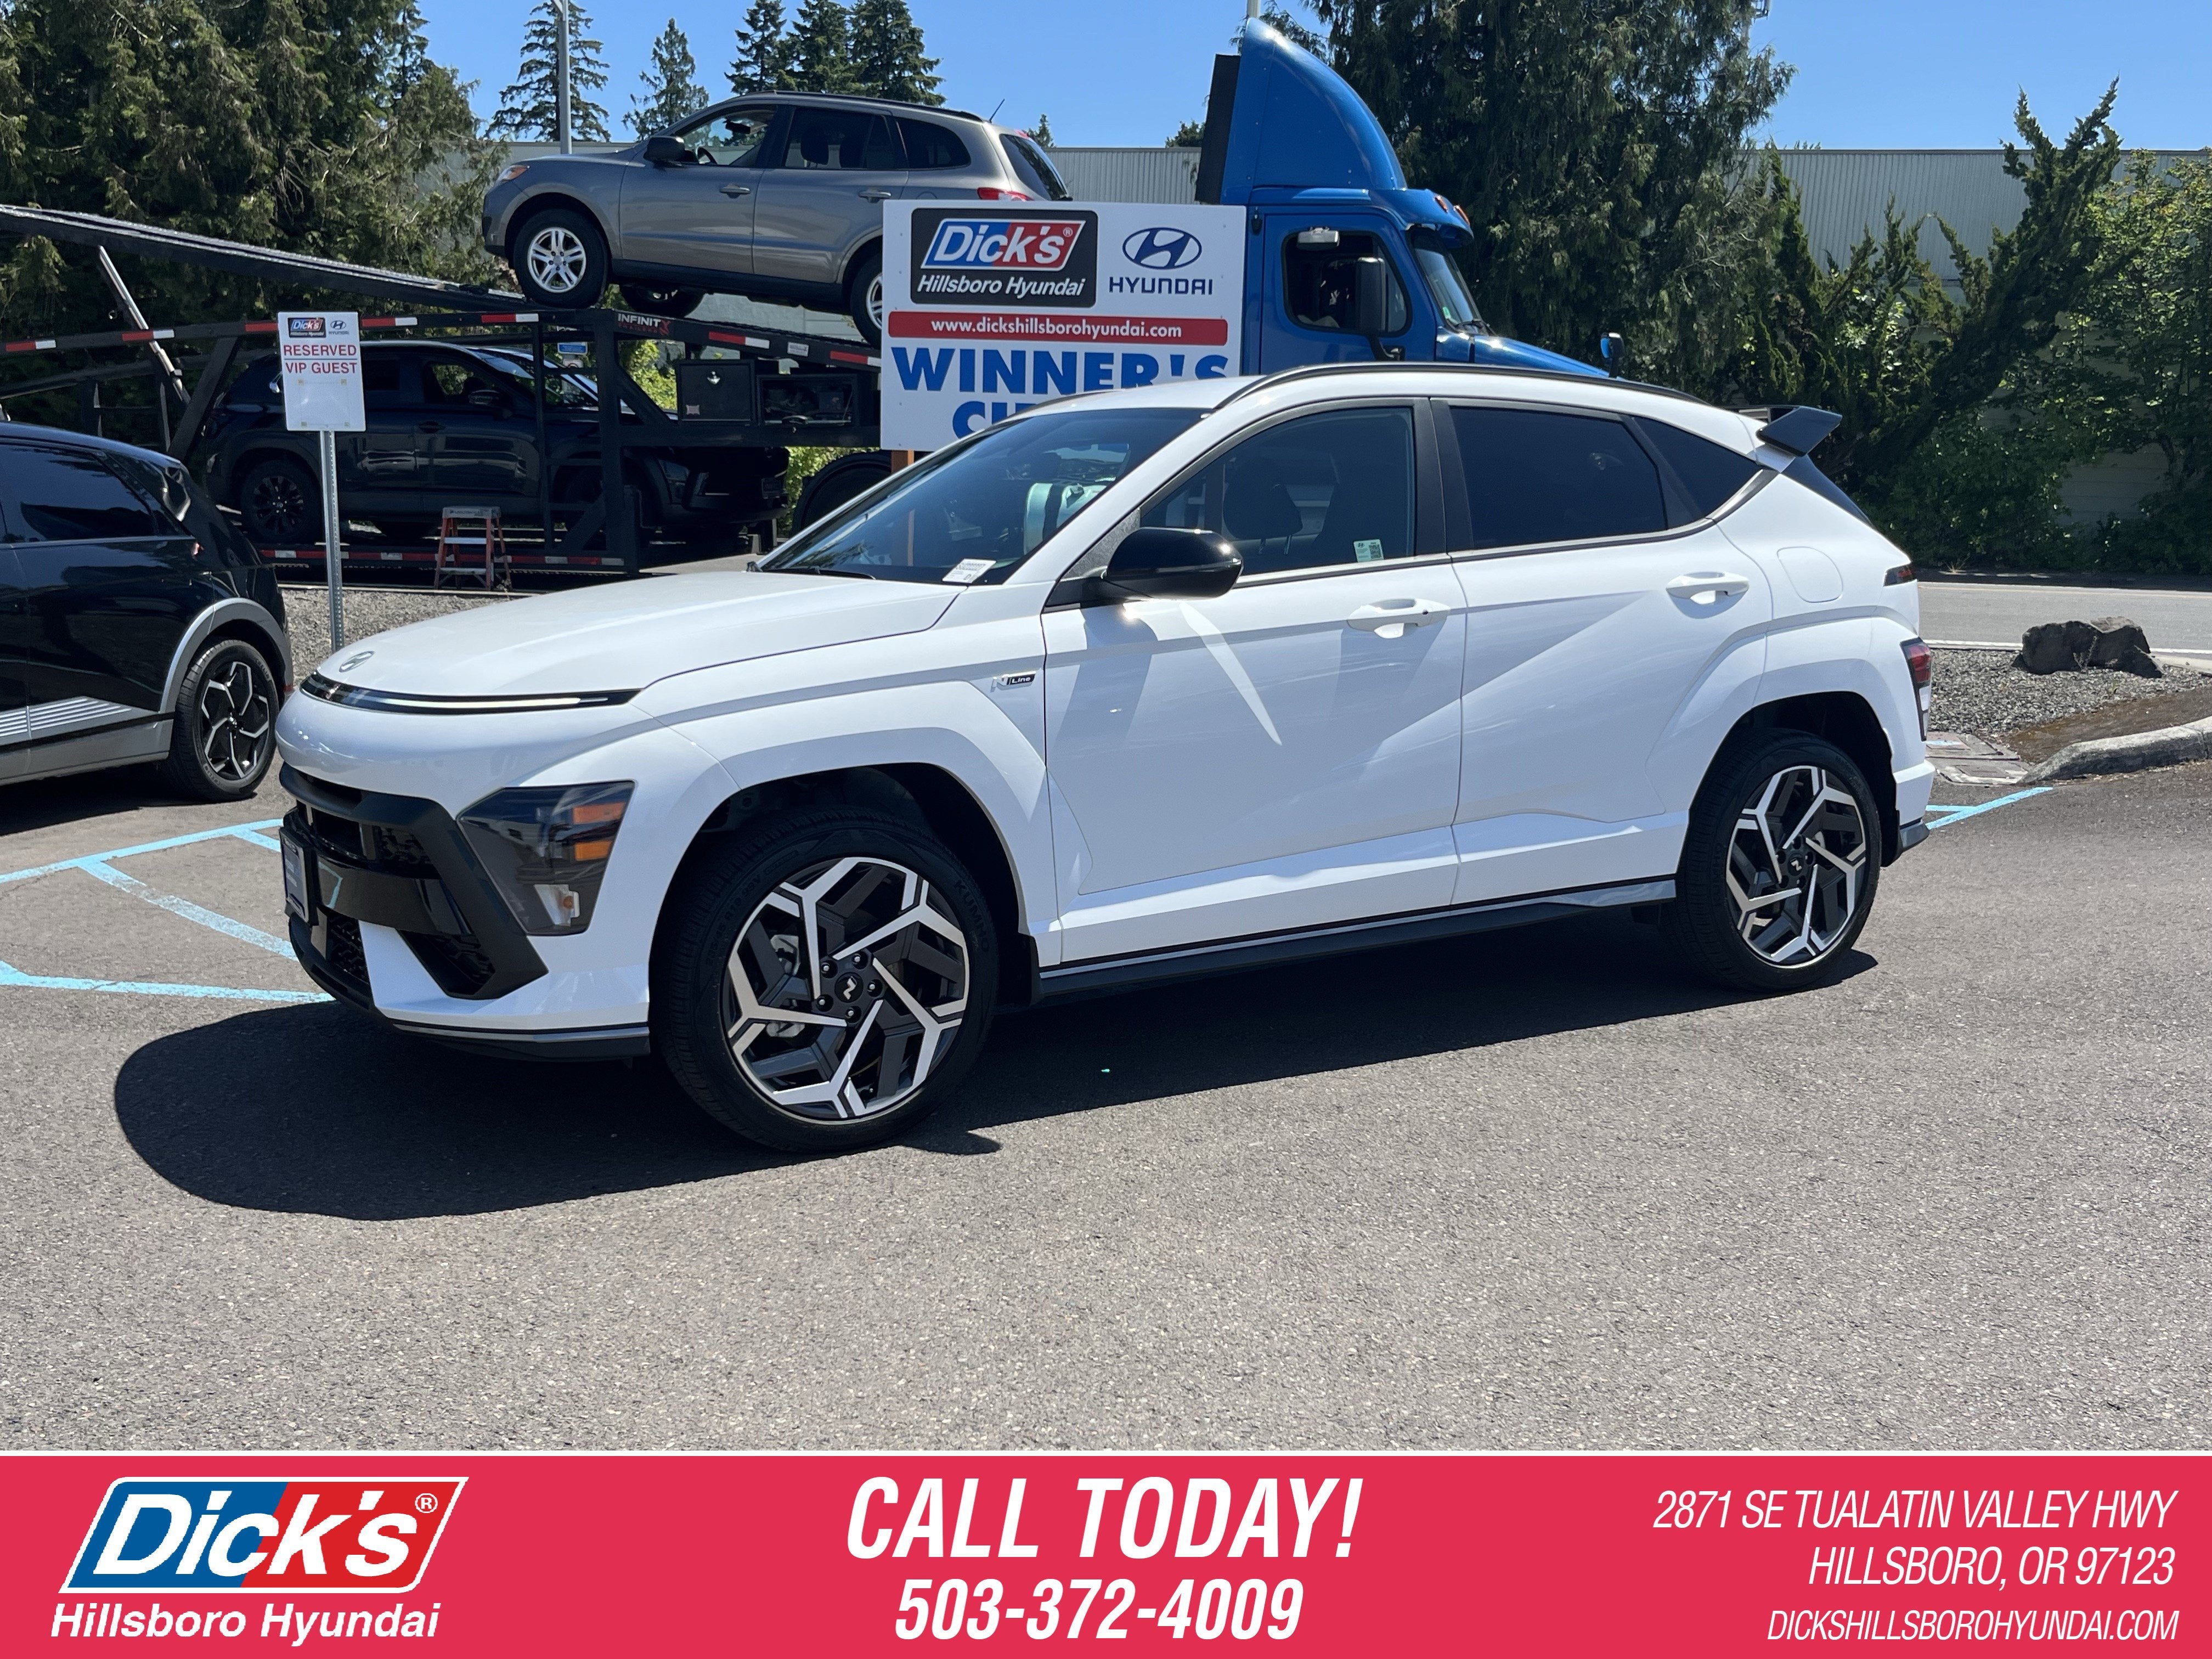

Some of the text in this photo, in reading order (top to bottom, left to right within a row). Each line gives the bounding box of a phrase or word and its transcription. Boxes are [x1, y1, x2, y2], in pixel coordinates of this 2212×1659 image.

[934, 225, 1065, 264] Dick's
[917, 275, 1086, 299] Hillsboro Hyundai
[1108, 276, 1213, 295] HYUNDAI
[931, 318, 1182, 339] www.dickshillsborohyundai.com
[283, 345, 357, 356] RESERVED
[285, 362, 358, 374] VIP GUEST
